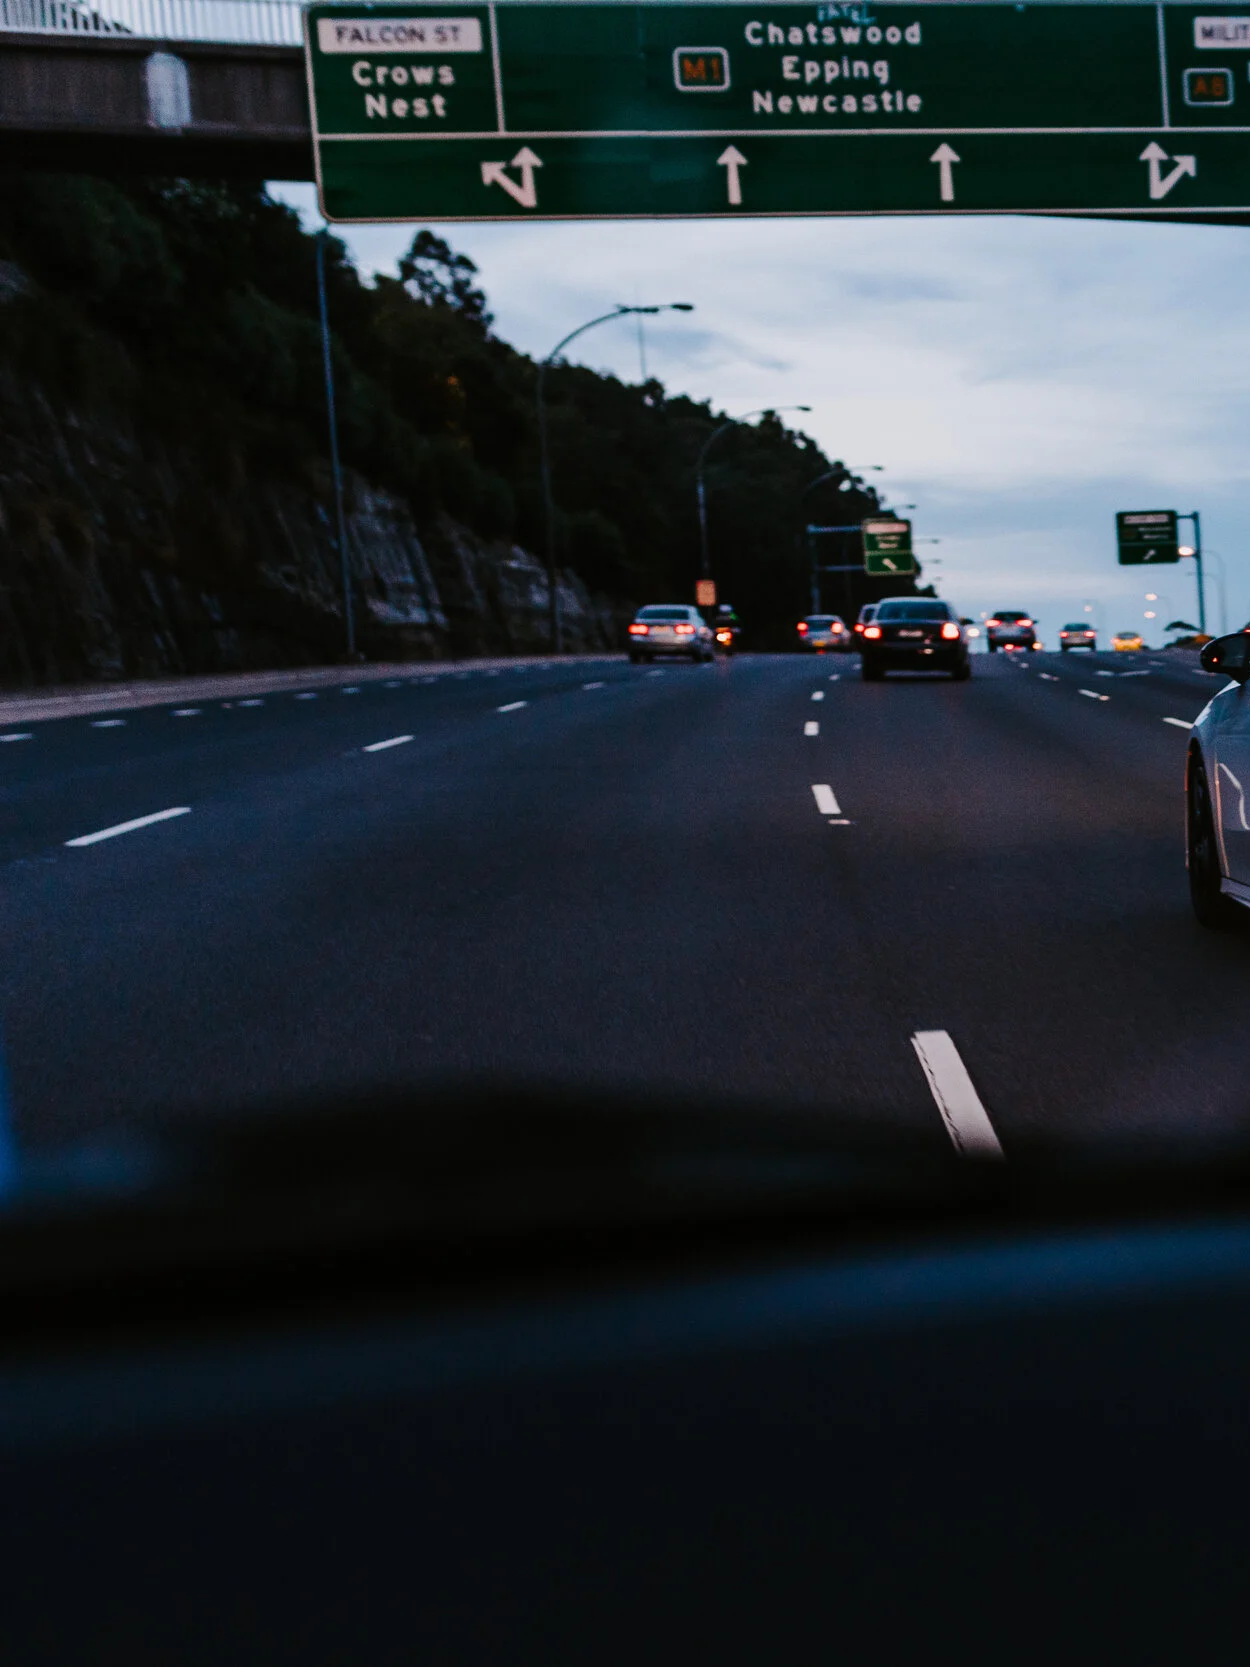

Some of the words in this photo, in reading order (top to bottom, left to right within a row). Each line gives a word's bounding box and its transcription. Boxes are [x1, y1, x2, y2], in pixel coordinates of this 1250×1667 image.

[336, 25, 424, 44] FALCON
[435, 25, 461, 43] ST
[744, 21, 922, 46] Chatswood
[351, 61, 455, 87] Crows
[682, 56, 722, 82] M1
[782, 56, 888, 84] Epping
[365, 94, 446, 118] Nest
[752, 91, 922, 114] Newcastle
